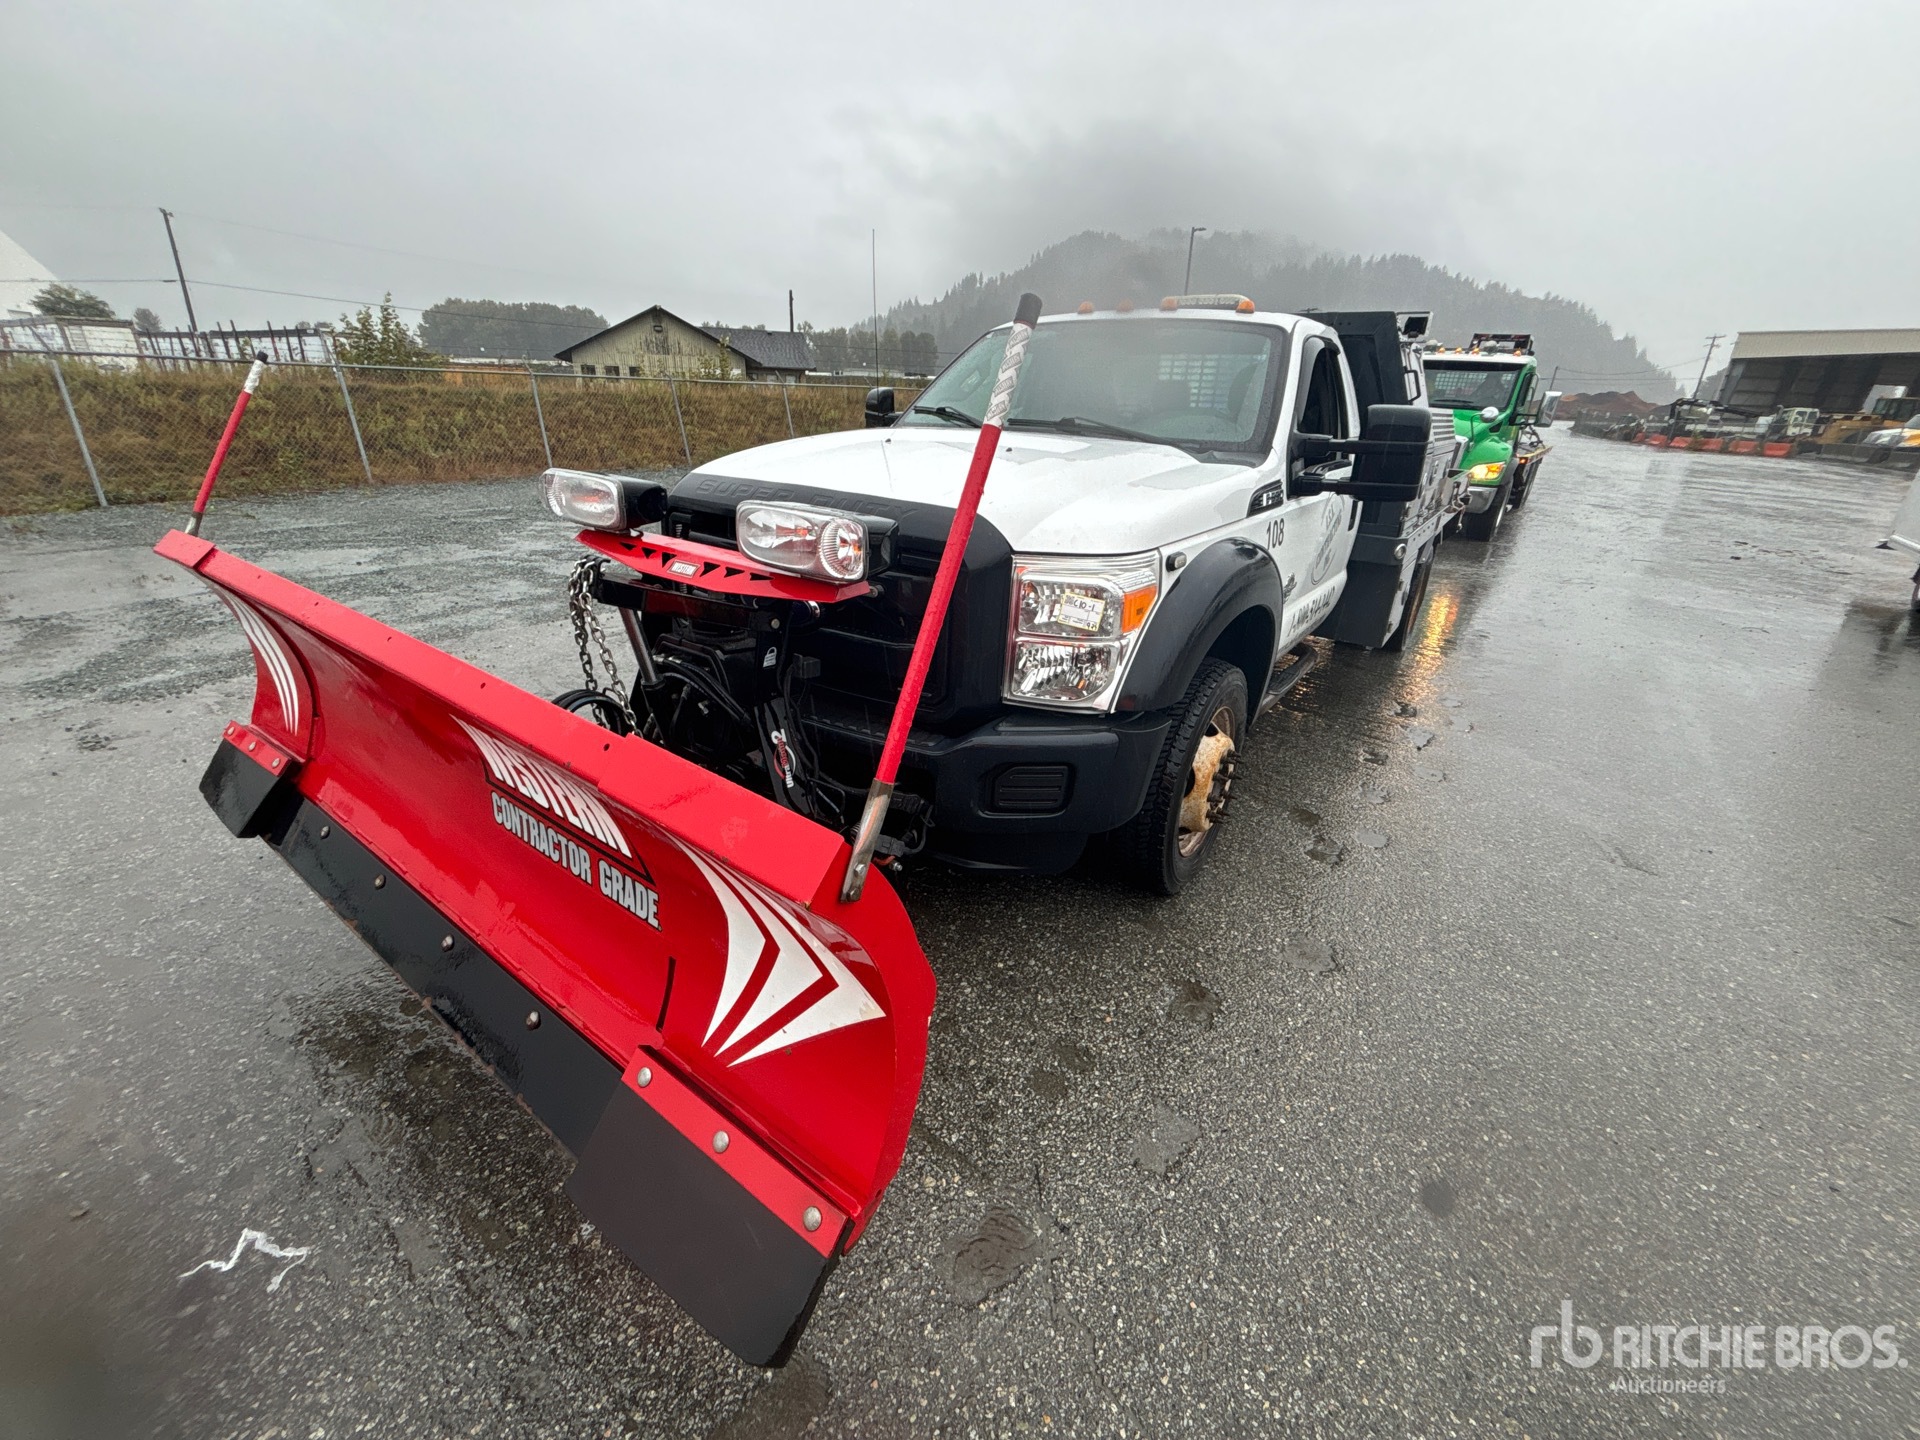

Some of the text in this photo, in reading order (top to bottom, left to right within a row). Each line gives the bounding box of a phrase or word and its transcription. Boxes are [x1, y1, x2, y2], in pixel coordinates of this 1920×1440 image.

[696, 479, 796, 502] SUPER
[1266, 518, 1285, 550] 108
[771, 728, 787, 745] 2
[449, 714, 633, 860] WESTERN
[491, 791, 661, 931] CONTRACTOR GRADE
